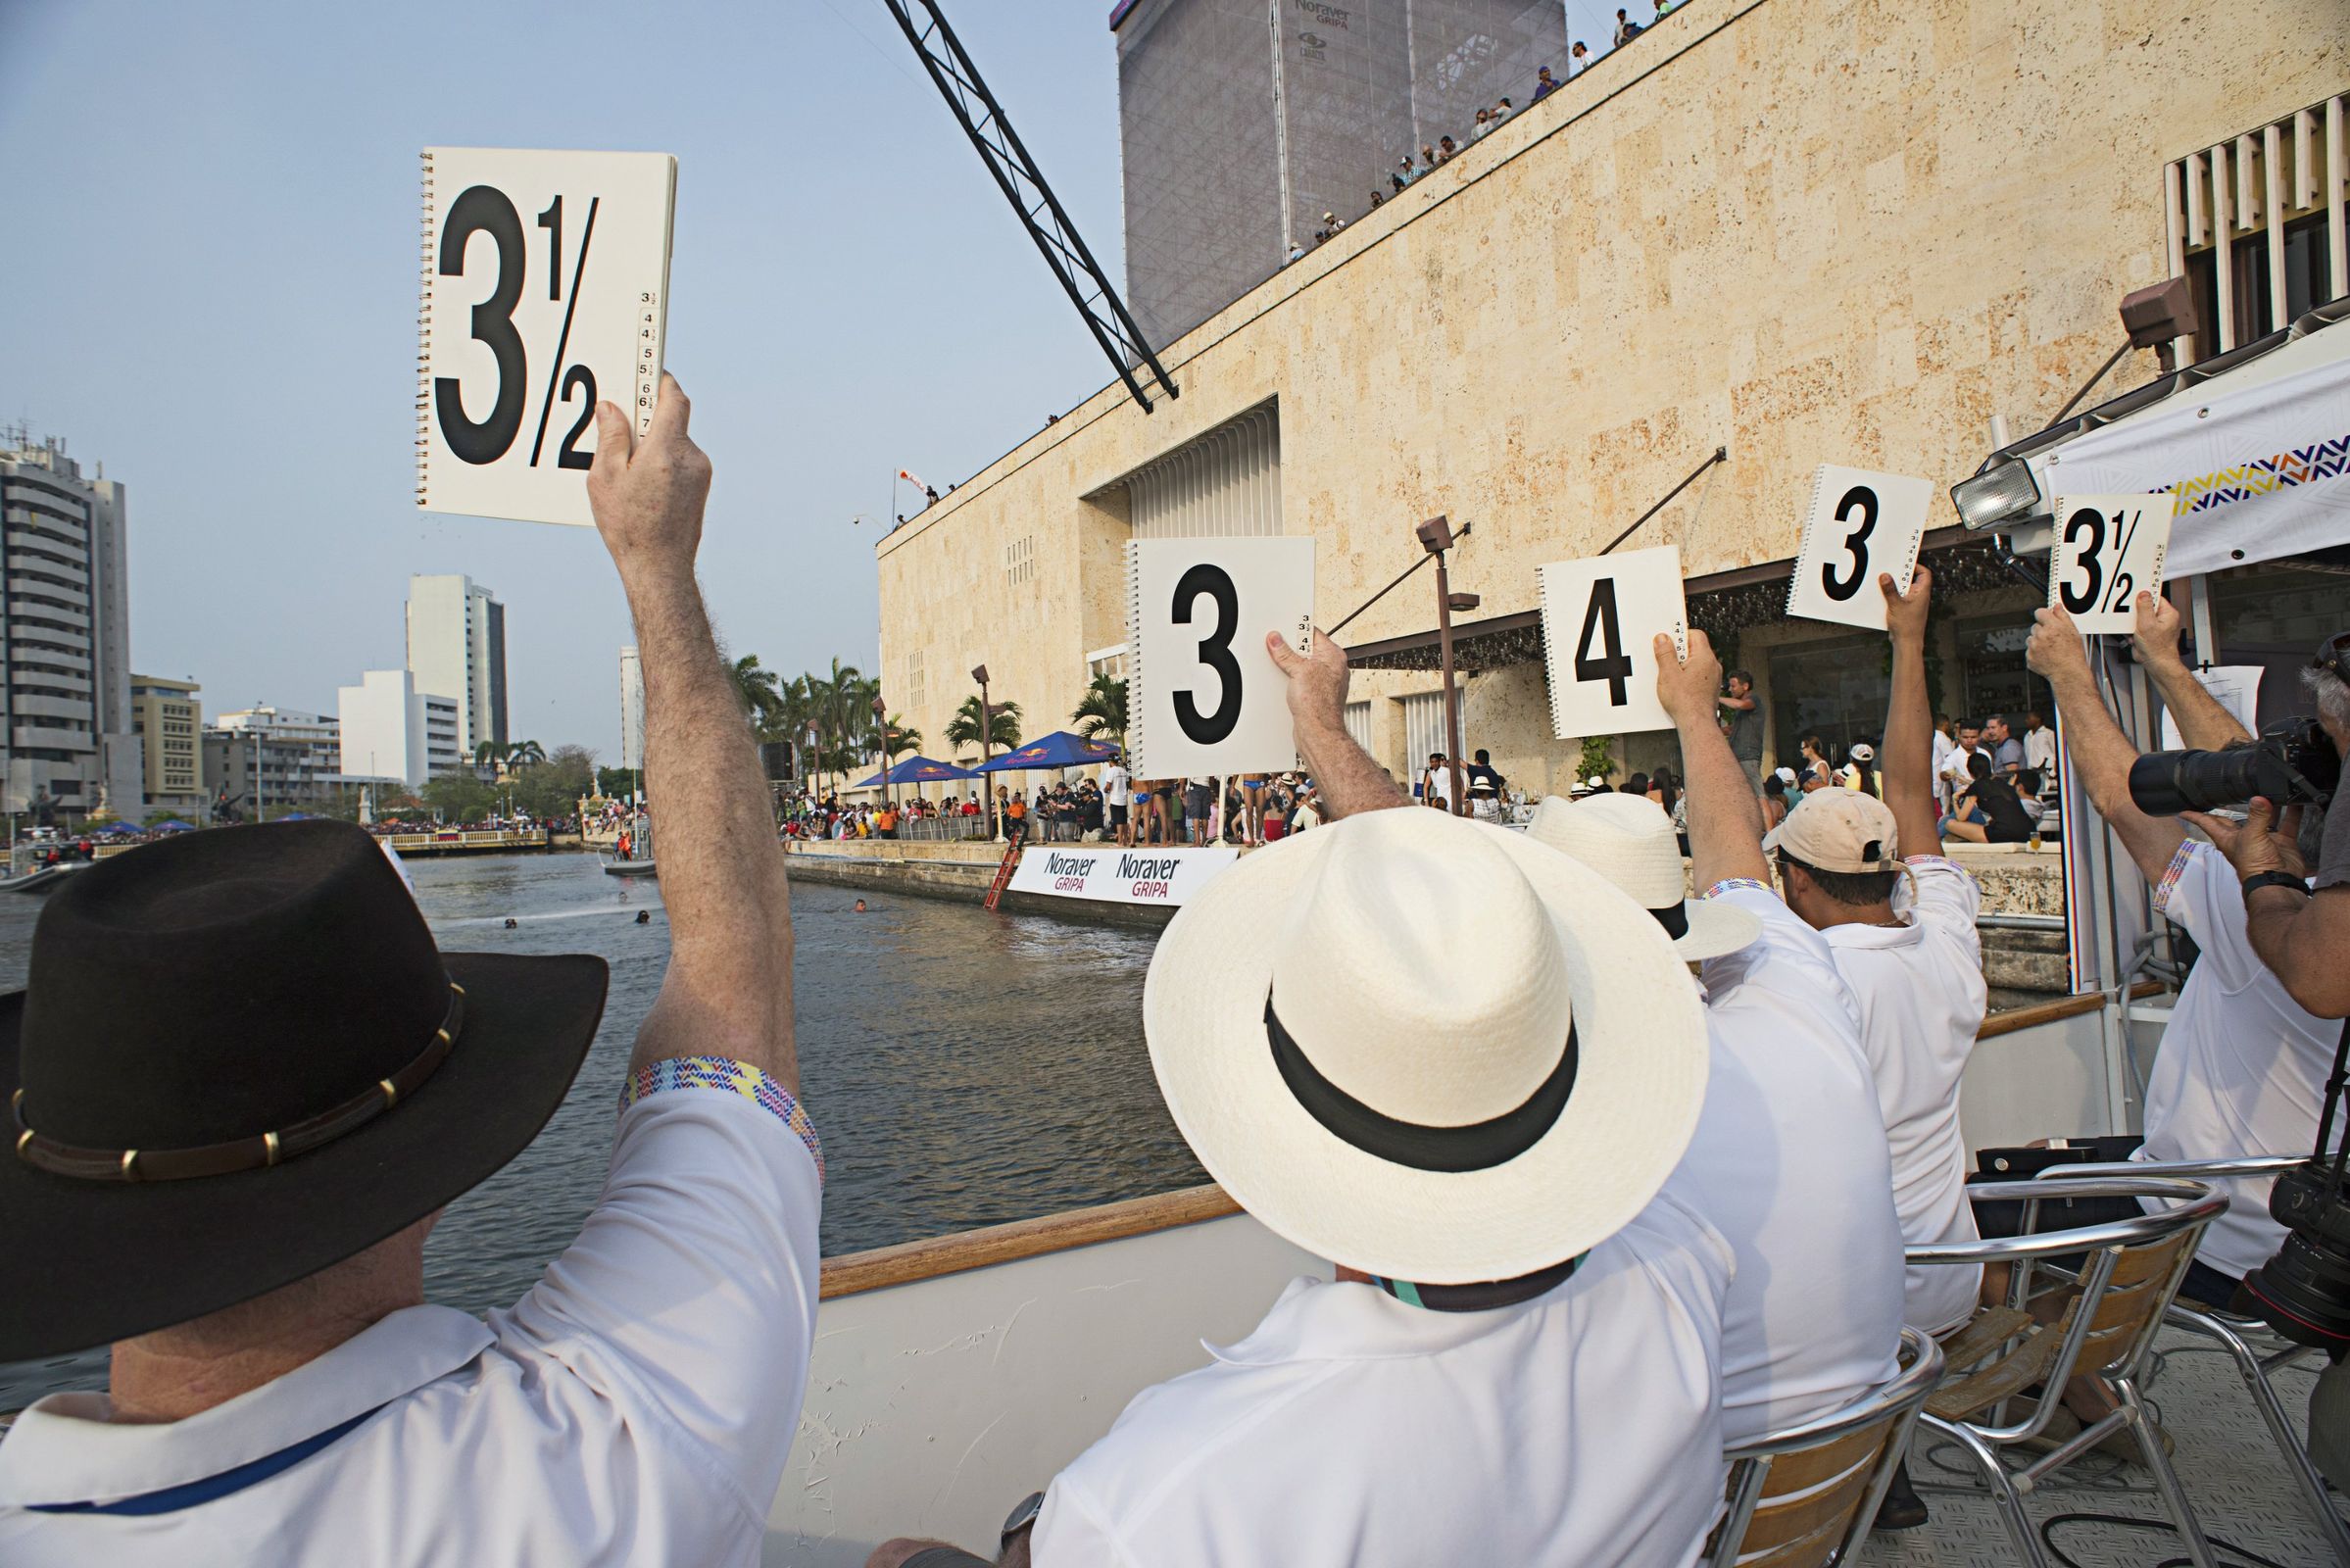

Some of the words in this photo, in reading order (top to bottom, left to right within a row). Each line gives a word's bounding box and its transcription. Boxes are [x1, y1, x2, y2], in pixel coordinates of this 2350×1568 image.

[644, 348, 653, 359] 5
[642, 384, 651, 393] 6
[642, 418, 650, 428] 7
[1821, 485, 1879, 602] 3
[1574, 577, 1633, 707] 4
[1171, 563, 1243, 745] 3
[1044, 852, 1097, 877] Noraver
[1115, 854, 1180, 880] Noraver
[1054, 877, 1085, 892] GRIPA
[1132, 881, 1168, 898] GRIPA
